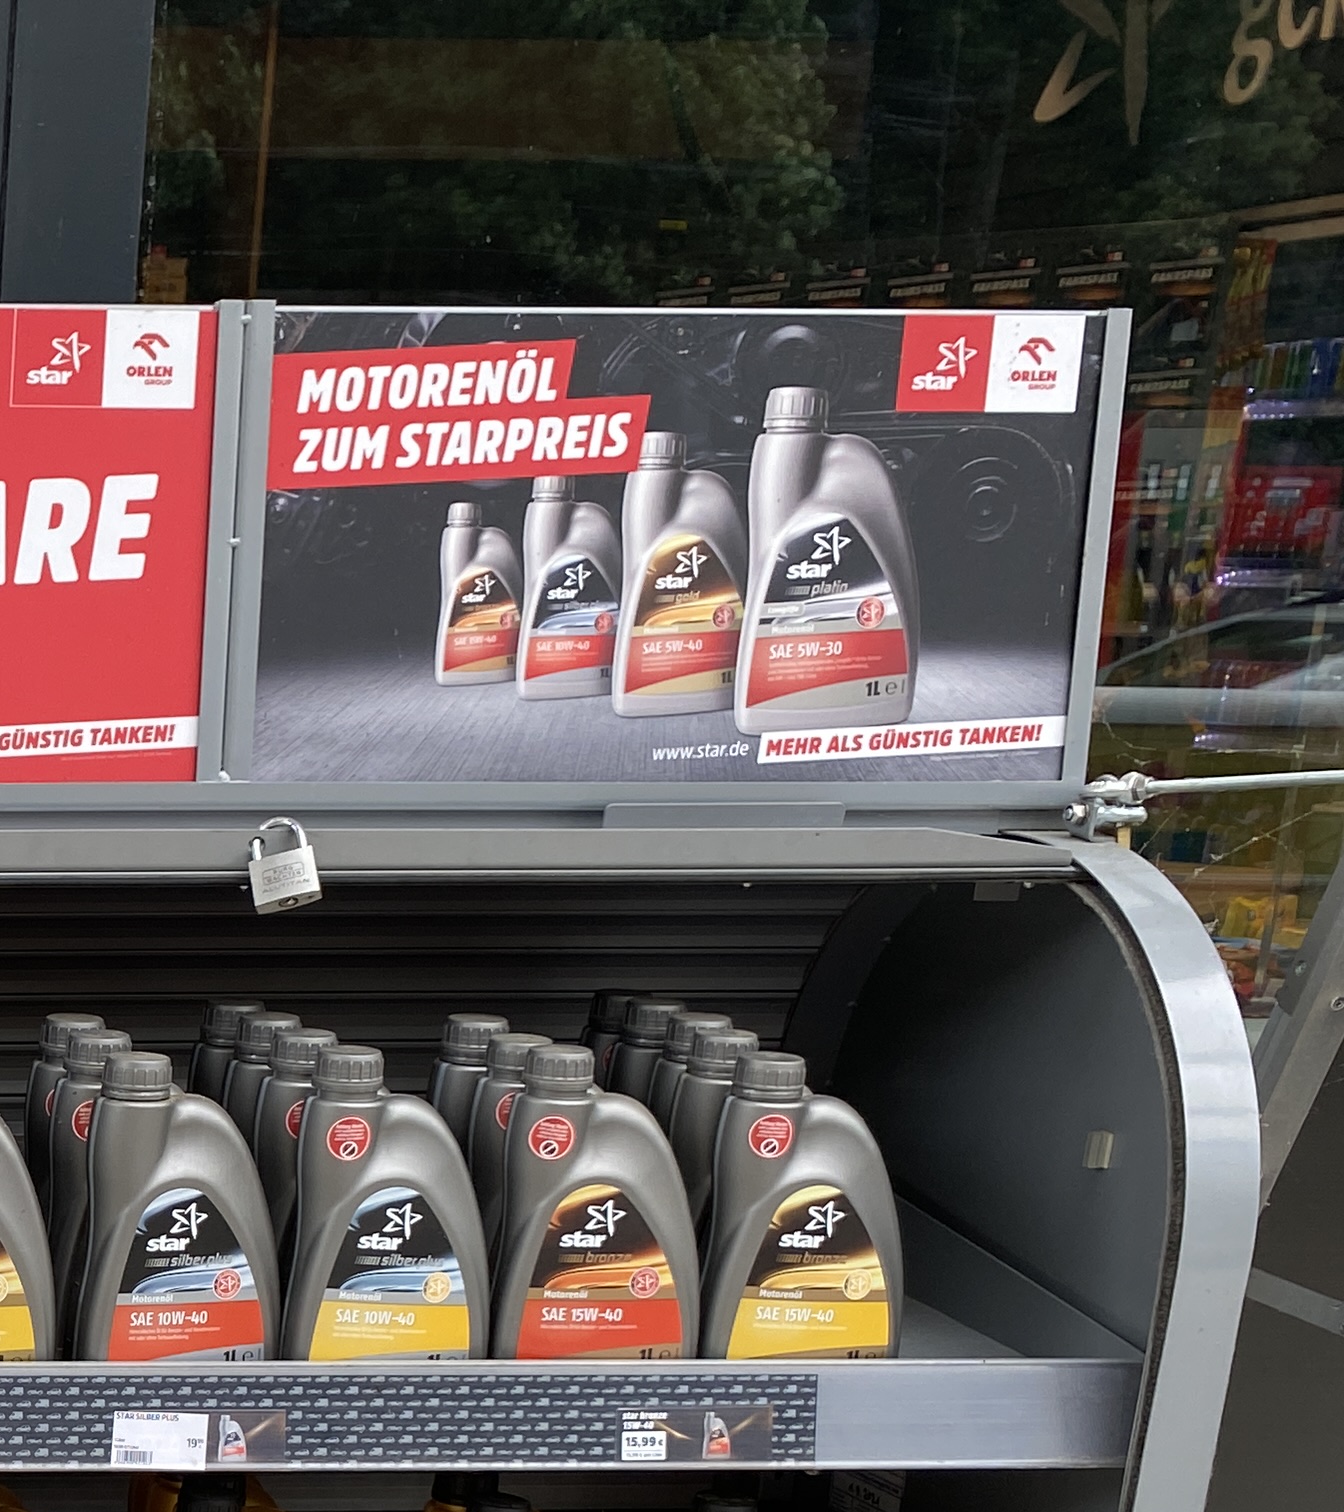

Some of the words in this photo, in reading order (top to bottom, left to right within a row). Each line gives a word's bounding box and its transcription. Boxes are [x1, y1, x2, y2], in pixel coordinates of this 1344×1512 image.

[25, 365, 74, 386] star
[125, 363, 175, 379] ORLEN
[1011, 370, 1057, 382] ORLEN
[296, 349, 559, 413] MOTORENÖL
[911, 372, 958, 392] star
[291, 424, 386, 474] ZUM
[395, 410, 634, 469] STARPREIS
[786, 560, 834, 580] star
[655, 573, 694, 591] star
[546, 587, 579, 601] star
[642, 640, 662, 654] SAE
[664, 638, 704, 653] 5W-40
[769, 642, 794, 660] SAE
[797, 640, 843, 657] 5W-30
[865, 680, 881, 697] 1L
[89, 722, 176, 748] TANKEN!
[765, 731, 823, 757] MEHR
[826, 729, 864, 752] ALS
[867, 725, 953, 751] GÜNSTIG
[958, 722, 1044, 748] TANKEN!
[652, 740, 750, 761] www.star.de
[146, 1235, 191, 1253] star
[357, 1234, 403, 1251] star
[559, 1230, 606, 1248] star
[778, 1231, 826, 1249] star
[130, 1311, 154, 1326] SAE
[157, 1309, 208, 1325] 10W-40
[335, 1309, 360, 1324] SAE
[364, 1309, 415, 1325] 10W-40
[541, 1307, 567, 1322] SAE
[571, 1307, 623, 1322] 15W-40
[755, 1307, 780, 1321] SAE
[784, 1307, 834, 1322] 15W-40
[116, 1412, 135, 1420] STAR
[162, 1414, 179, 1422] PLUS
